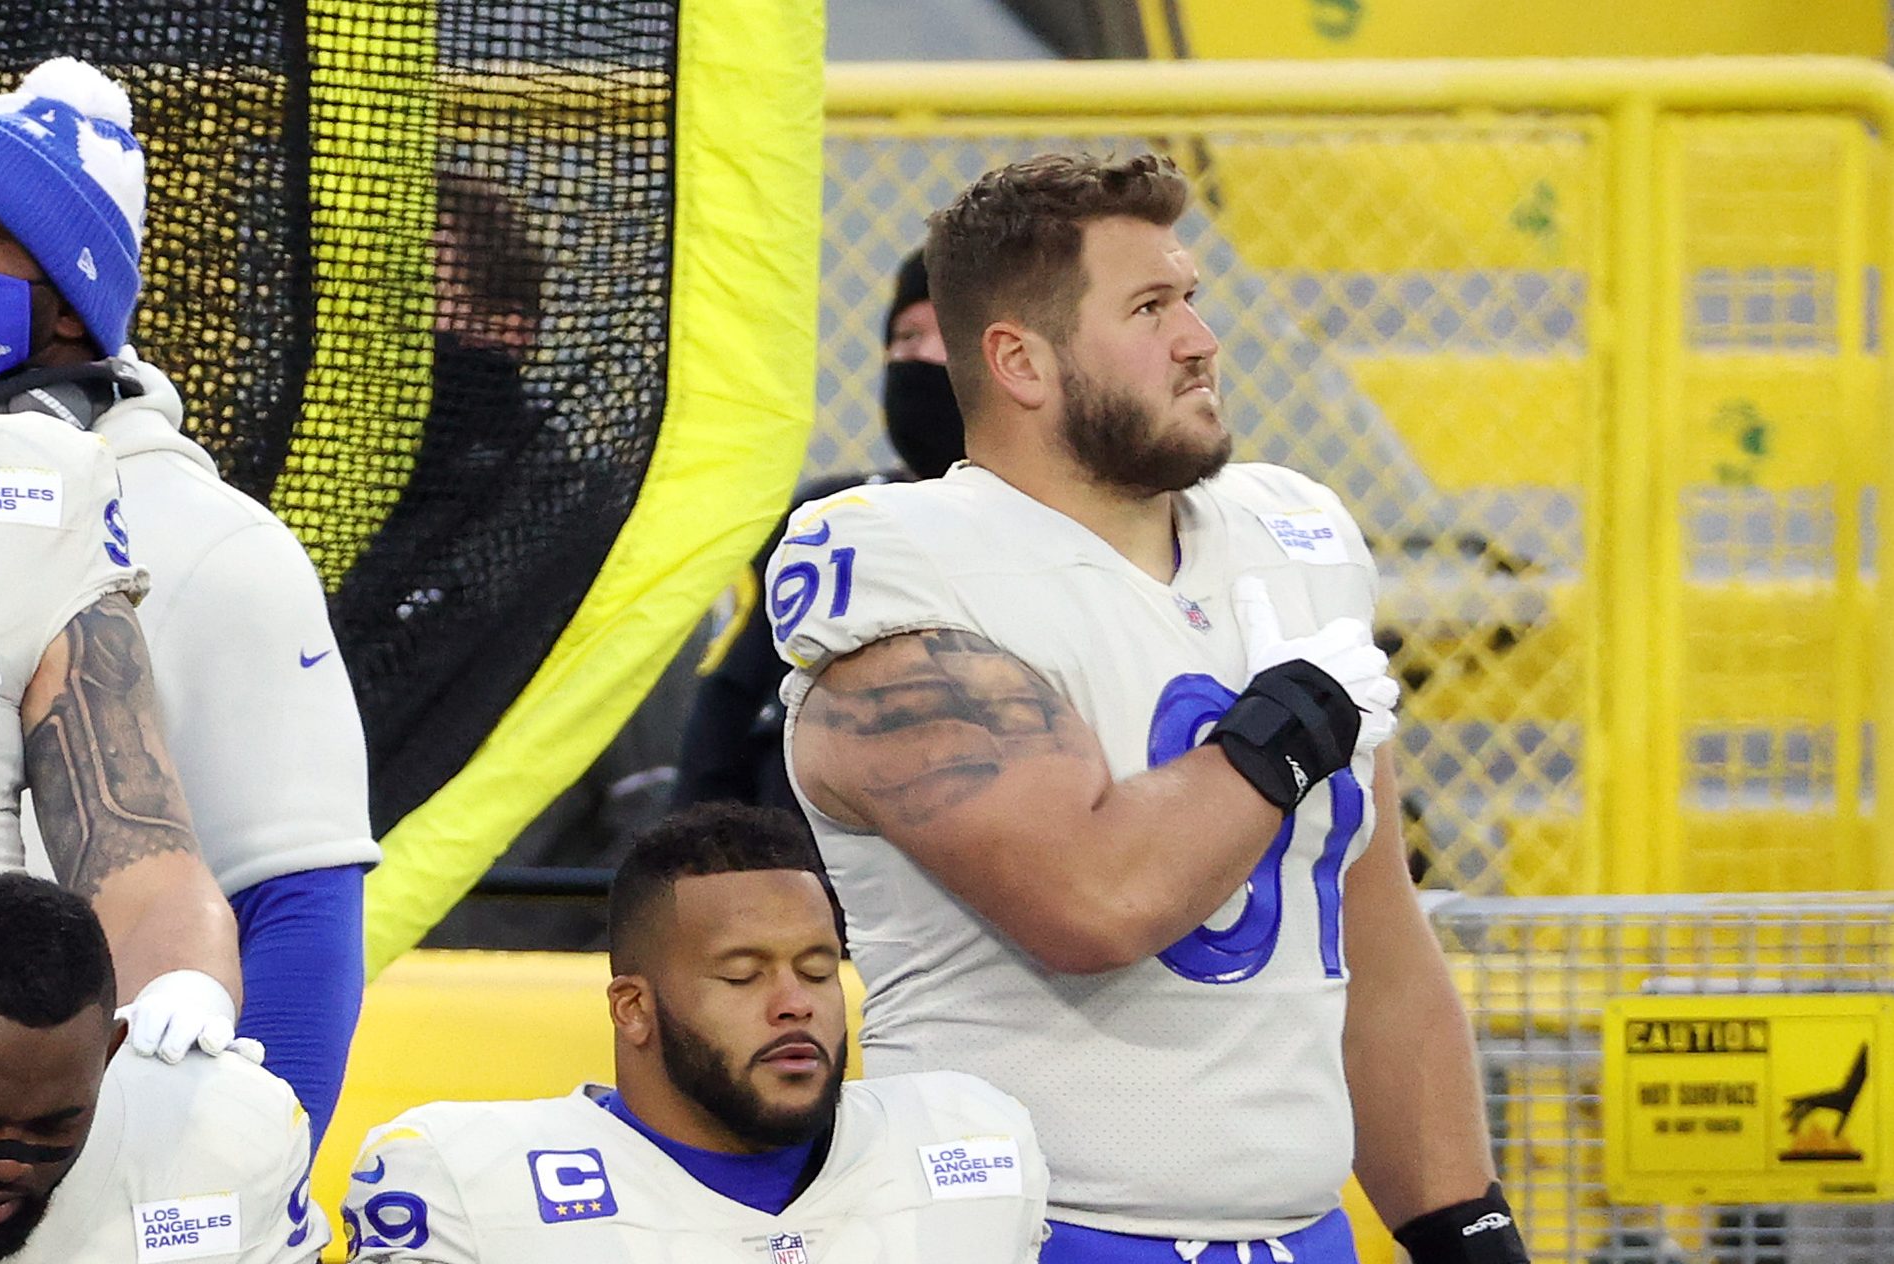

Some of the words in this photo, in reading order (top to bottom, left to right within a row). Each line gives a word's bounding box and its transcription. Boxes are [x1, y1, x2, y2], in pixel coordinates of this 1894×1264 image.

[772, 547, 856, 643] 91
[927, 1148, 967, 1164] LOS
[933, 1156, 1015, 1175] ANGELES
[535, 1153, 606, 1202] C
[936, 1170, 988, 1187] RAMS
[142, 1208, 181, 1223] LOS
[144, 1214, 232, 1236] ANGELES
[145, 1232, 200, 1249] RAMS
